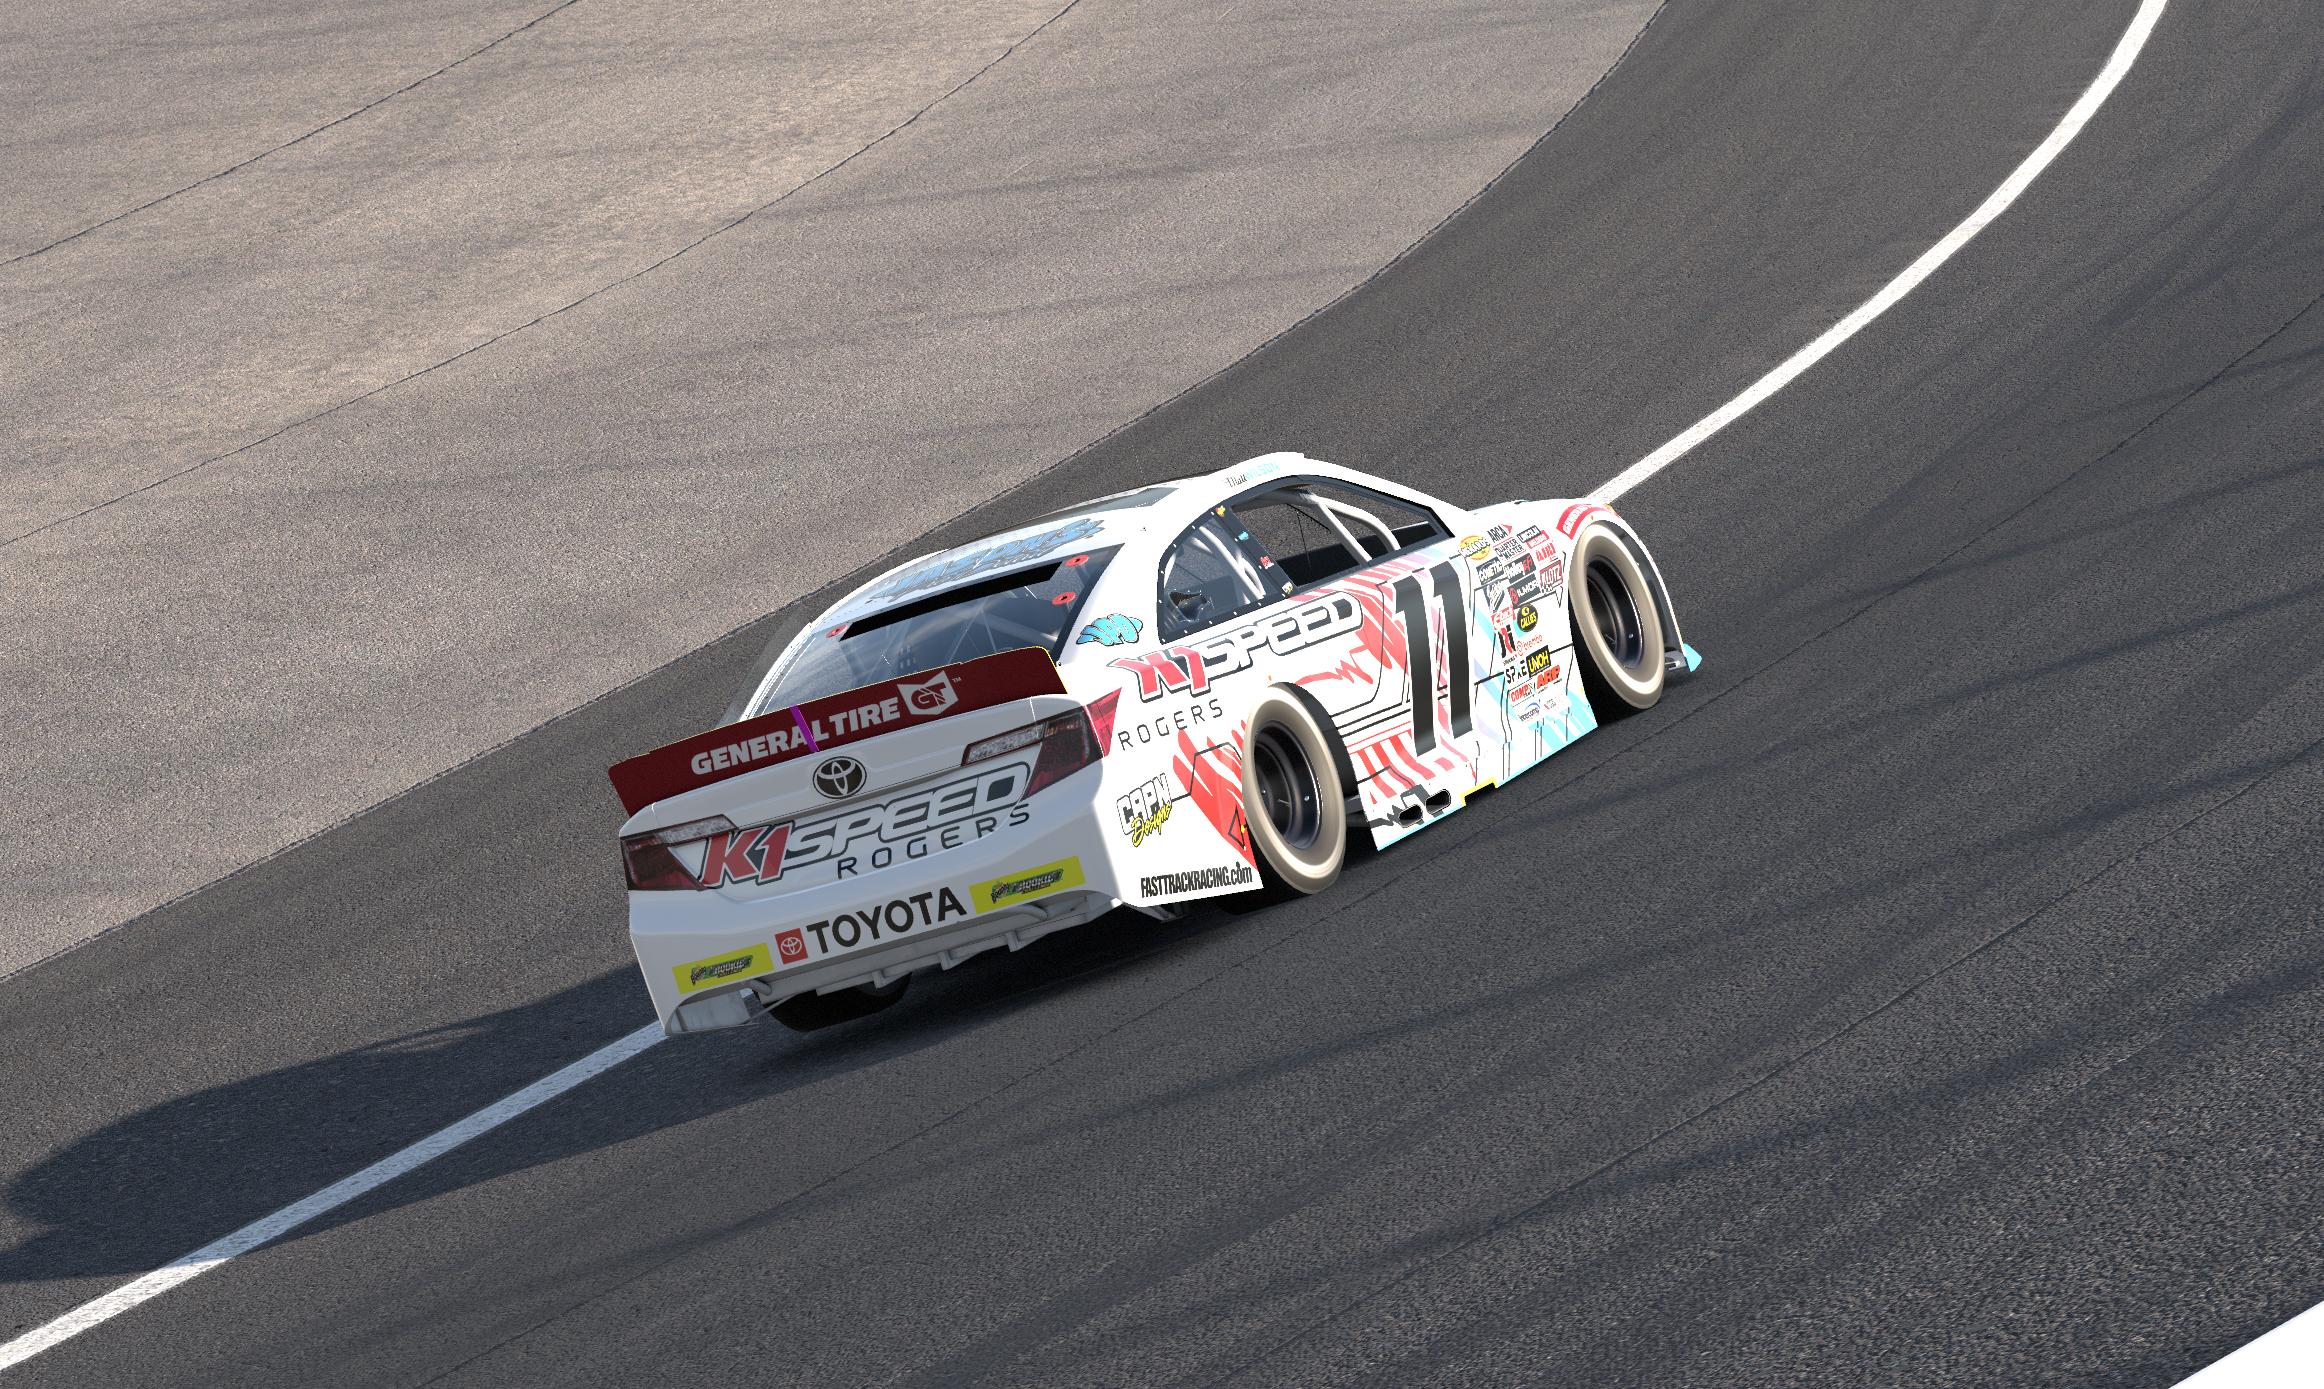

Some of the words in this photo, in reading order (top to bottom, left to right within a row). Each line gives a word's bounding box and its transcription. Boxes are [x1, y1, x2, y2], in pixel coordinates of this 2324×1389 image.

[1487, 525, 1509, 543] ARCA
[1199, 590, 1364, 681] SPEED
[1520, 612, 1537, 628] CALLIES
[1392, 560, 1473, 757] 11
[1528, 651, 1550, 673] UNOH
[1537, 665, 1560, 689] ARP
[1511, 684, 1529, 703] COMP
[691, 719, 829, 776] GENERAL
[828, 696, 901, 737] TIRE
[1118, 698, 1223, 751] ROGERS
[699, 821, 795, 889] K1
[783, 761, 1031, 870] SPEED
[838, 803, 1031, 880] ROGERS
[1140, 862, 1253, 898] FASTTRACKRACING.com
[806, 887, 967, 954] TOYOTA
